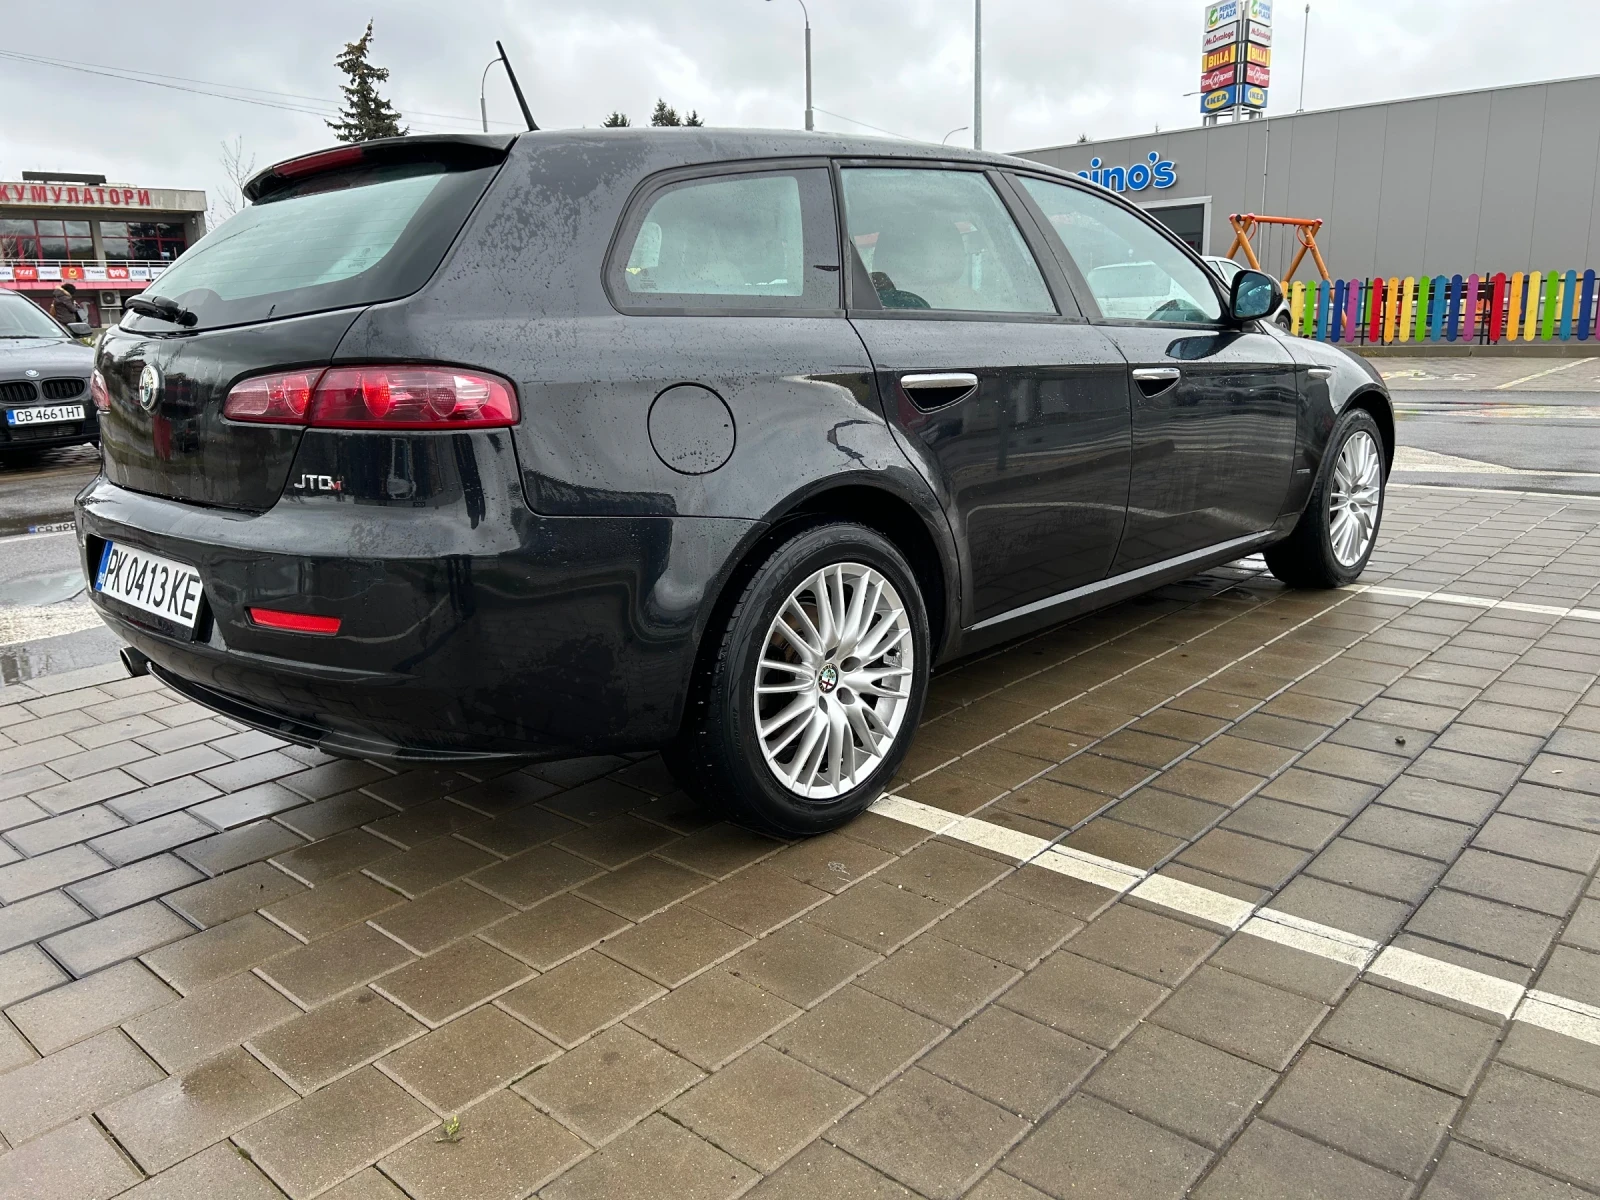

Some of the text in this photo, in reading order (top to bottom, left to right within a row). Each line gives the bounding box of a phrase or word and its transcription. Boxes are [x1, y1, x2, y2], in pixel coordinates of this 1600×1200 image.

[1219, 8, 1237, 20] PLAZA
[1207, 50, 1230, 68] BILLA
[1251, 47, 1266, 61] BILLA
[1206, 93, 1227, 106] IKEA
[1249, 90, 1264, 101] IKEA
[1077, 151, 1177, 193] ino's
[16, 406, 81, 422] CB 4661 HT
[103, 548, 201, 620] PK 0413 KE
